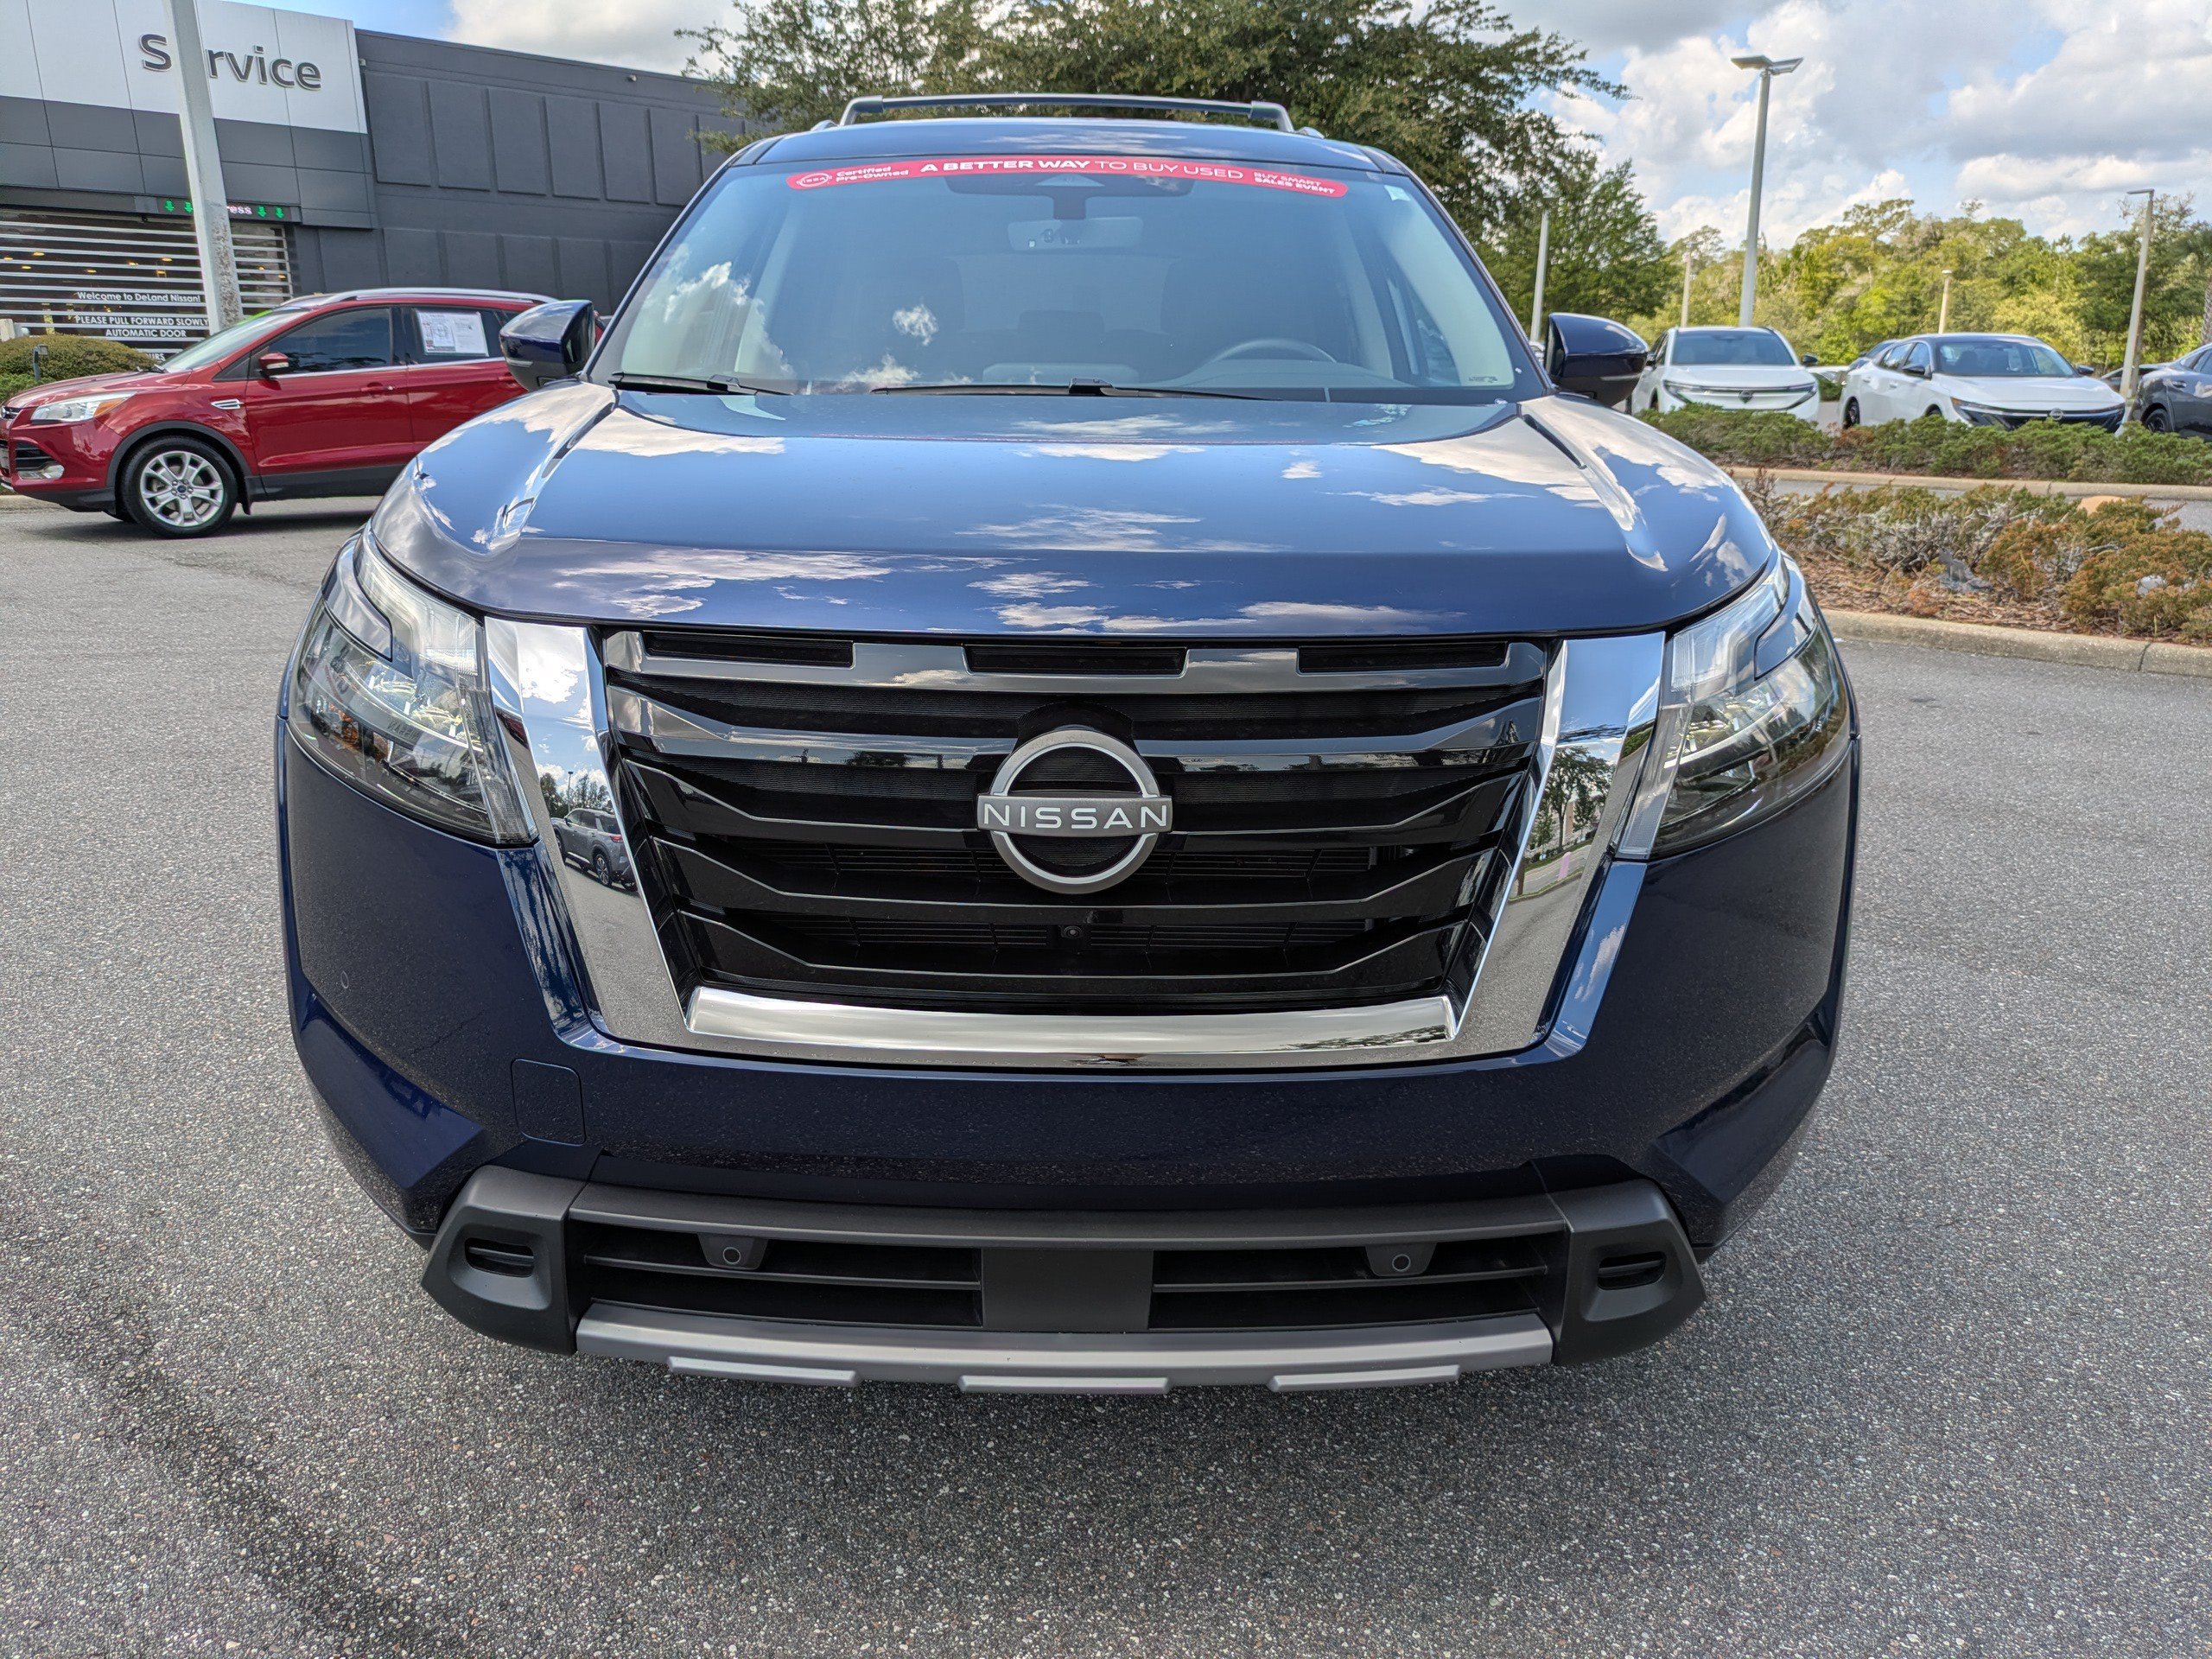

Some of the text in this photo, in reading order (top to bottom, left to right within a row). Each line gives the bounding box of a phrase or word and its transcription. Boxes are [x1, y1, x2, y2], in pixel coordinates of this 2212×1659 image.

[139, 34, 321, 90] Srvice
[836, 166, 892, 177] Certified
[920, 160, 1244, 179] A BETTER WAY TO BUY USED
[1254, 177, 1336, 194] SALES EVENT
[1280, 175, 1322, 187] SMART
[77, 291, 122, 302] Welcome
[123, 292, 132, 301] to
[134, 293, 169, 302] DeLand
[76, 315, 209, 326] PLEASE PULL FORWARD SLOWLY
[105, 328, 187, 338] AUTOMATIC DOOR
[983, 804, 1167, 830] NISSAN
